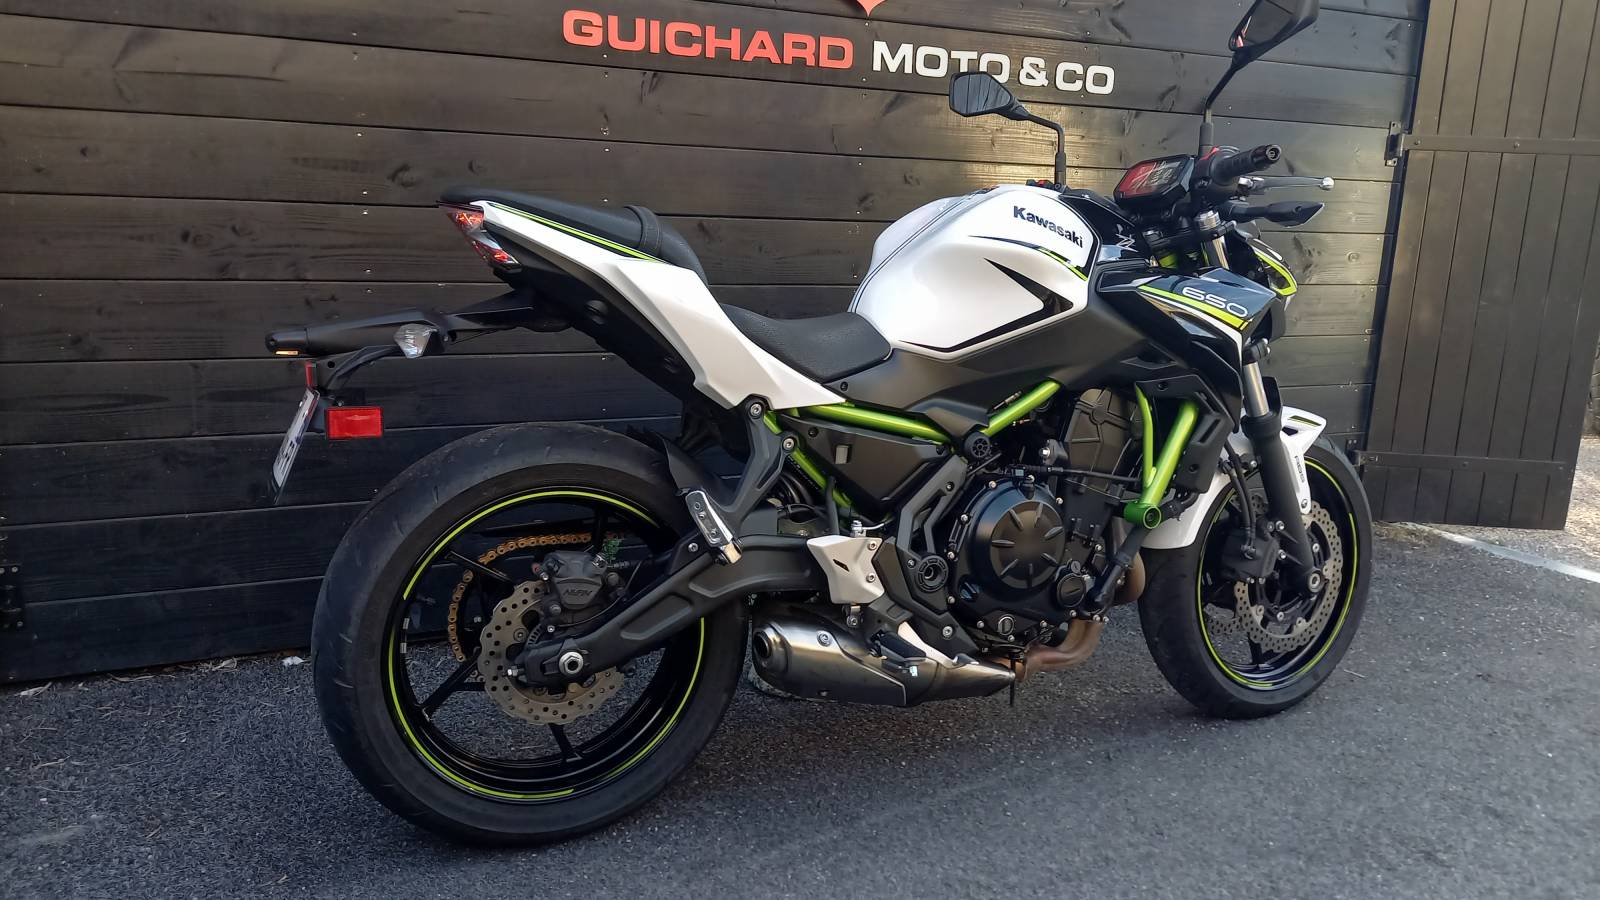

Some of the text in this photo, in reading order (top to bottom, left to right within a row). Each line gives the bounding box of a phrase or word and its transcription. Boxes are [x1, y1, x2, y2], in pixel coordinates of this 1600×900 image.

[562, 9, 854, 69] GUICHARD
[873, 40, 1011, 84] MOTO
[1013, 205, 1083, 249] Kawasaki
[1182, 286, 1249, 318] 650
